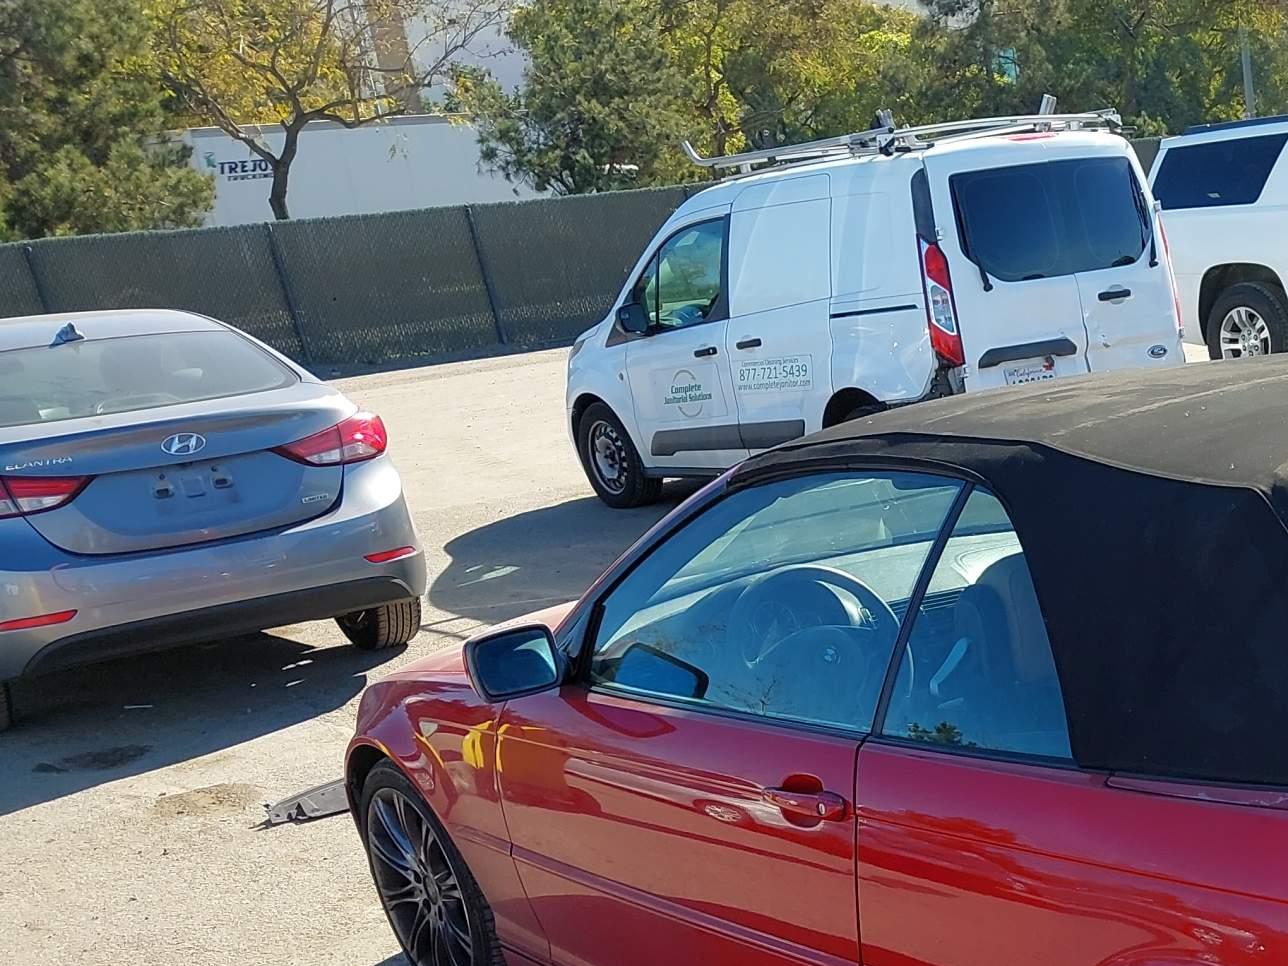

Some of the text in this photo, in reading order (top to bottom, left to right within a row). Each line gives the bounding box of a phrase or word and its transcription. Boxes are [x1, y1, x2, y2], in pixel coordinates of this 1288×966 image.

[739, 364, 808, 381] 877-721-5439
[671, 384, 702, 395] Complete
[738, 380, 811, 390] www.completejanitor.com
[664, 392, 712, 405] Janitorial Solutions
[5, 456, 73, 471] ELANTRA
